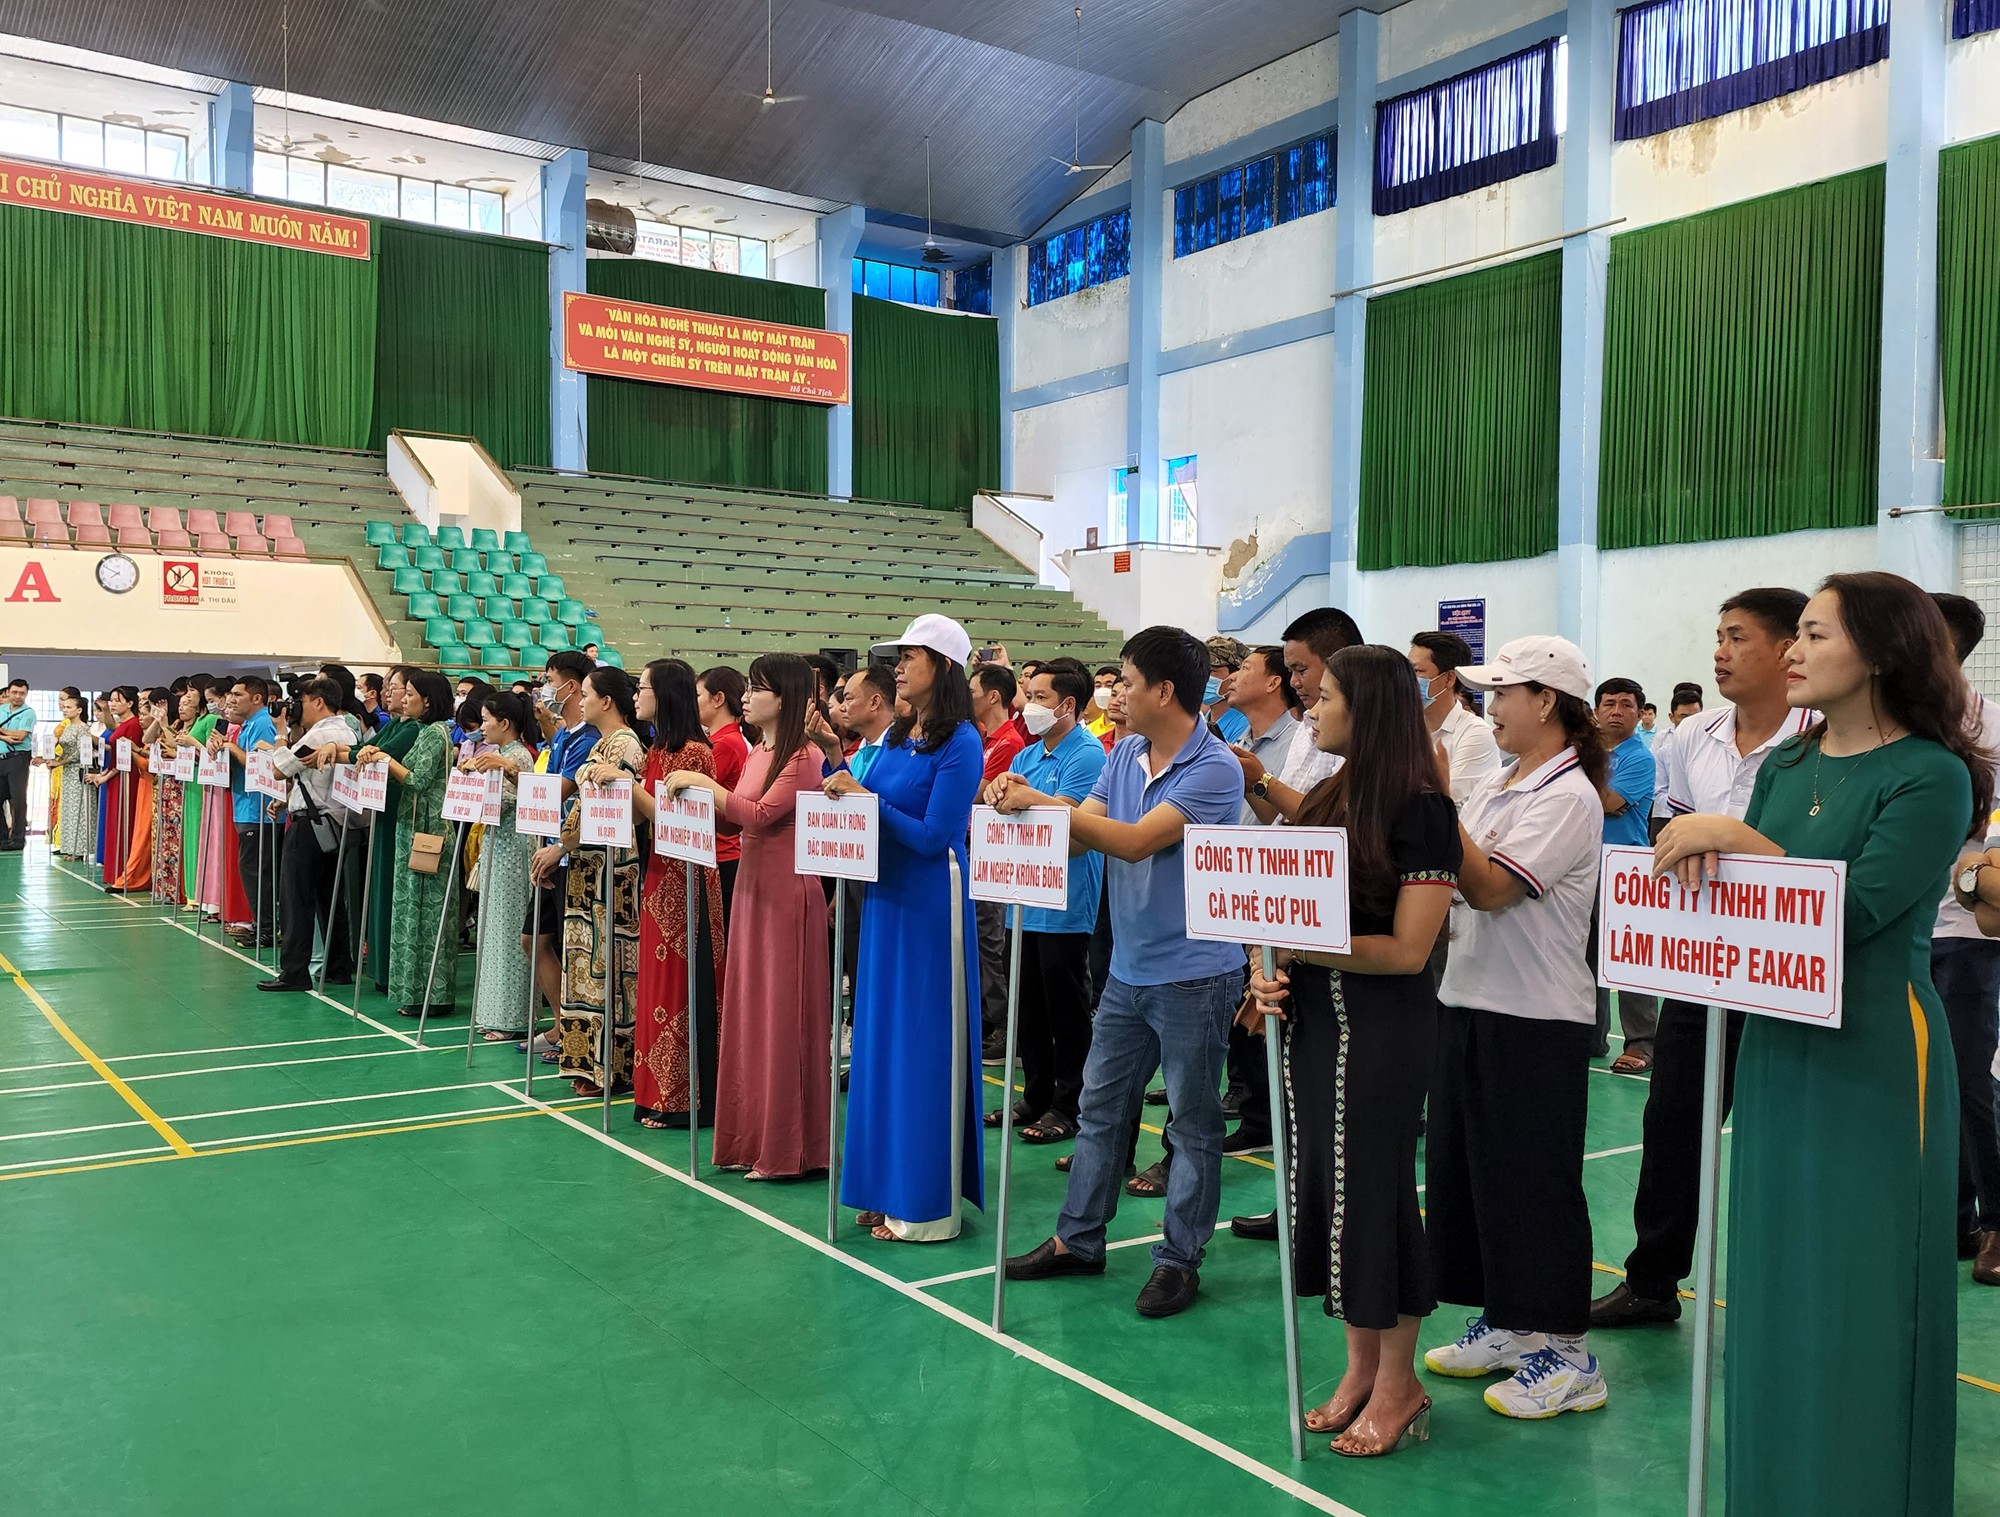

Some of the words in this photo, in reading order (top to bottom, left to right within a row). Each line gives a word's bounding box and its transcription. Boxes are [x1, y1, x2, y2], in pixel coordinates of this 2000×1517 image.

[15, 174, 62, 202] CHỦ
[69, 184, 138, 214] NGHĨA
[142, 195, 192, 225] VIỆT
[198, 205, 244, 231] NAM
[249, 213, 303, 240] MUÔN
[309, 220, 358, 249] NĂM!
[578, 321, 593, 337] VÀ
[620, 329, 643, 344] VĂN
[646, 333, 676, 352] NGHỆ
[696, 340, 731, 357] NGƯỜI
[733, 345, 760, 362] HOẠT
[762, 348, 792, 365] ĐỘNG
[794, 353, 814, 368] VĂN
[817, 356, 838, 371] HÓA
[634, 311, 658, 328] HÓA
[660, 316, 690, 335] NGHỆ
[692, 321, 725, 339] THUẬT
[727, 325, 740, 340] LÀ
[742, 328, 765, 345] MỘT
[789, 335, 815, 352] TRẬN
[604, 344, 619, 360] LÀ
[622, 348, 648, 366] MỘT
[650, 351, 685, 369] CHIẾN
[704, 360, 731, 375] TRÊN
[761, 367, 790, 384] TRẬN
[790, 385, 801, 393] Hồ
[801, 386, 816, 395] Chủ
[817, 388, 833, 397] Tịch
[4, 561, 61, 602] A
[660, 791, 674, 813] CÔNG
[684, 798, 698, 818] TNHH
[807, 811, 820, 828] BAN
[821, 807, 838, 830] QUẢN
[839, 810, 847, 830] LÝ
[848, 810, 866, 831] RỪNG
[658, 820, 669, 842] LÂM
[670, 824, 691, 851] NGHIỆP
[807, 836, 820, 860] ĐẶC
[821, 840, 838, 861] DỤNG
[839, 842, 854, 860] NAM
[856, 843, 865, 861] KA
[987, 817, 1006, 845] CÔNG
[1007, 823, 1015, 845] TY
[1016, 823, 1034, 846] TNHH
[1035, 824, 1053, 848] MTV
[973, 855, 989, 882] LÂM
[989, 857, 1015, 890] NGHIỆP
[1015, 858, 1040, 888] KRÔNG
[1042, 860, 1063, 890] BÔNG
[1195, 840, 1232, 873] CÔNG
[1236, 847, 1253, 874] TY
[1258, 847, 1299, 877] TNHH
[1304, 849, 1334, 878] HTV
[1208, 886, 1228, 919] CÀ
[1231, 889, 1260, 922] PHÊ
[1264, 894, 1286, 925] CƯ
[1290, 897, 1322, 928] PUL
[1614, 866, 1671, 910] CÔNG
[1708, 880, 1767, 920] TNHH
[1774, 886, 1826, 927] MTV
[1610, 923, 1654, 967] LÂM
[1660, 935, 1740, 986] NGHIỆP
[1748, 946, 1826, 994] EAKAR
